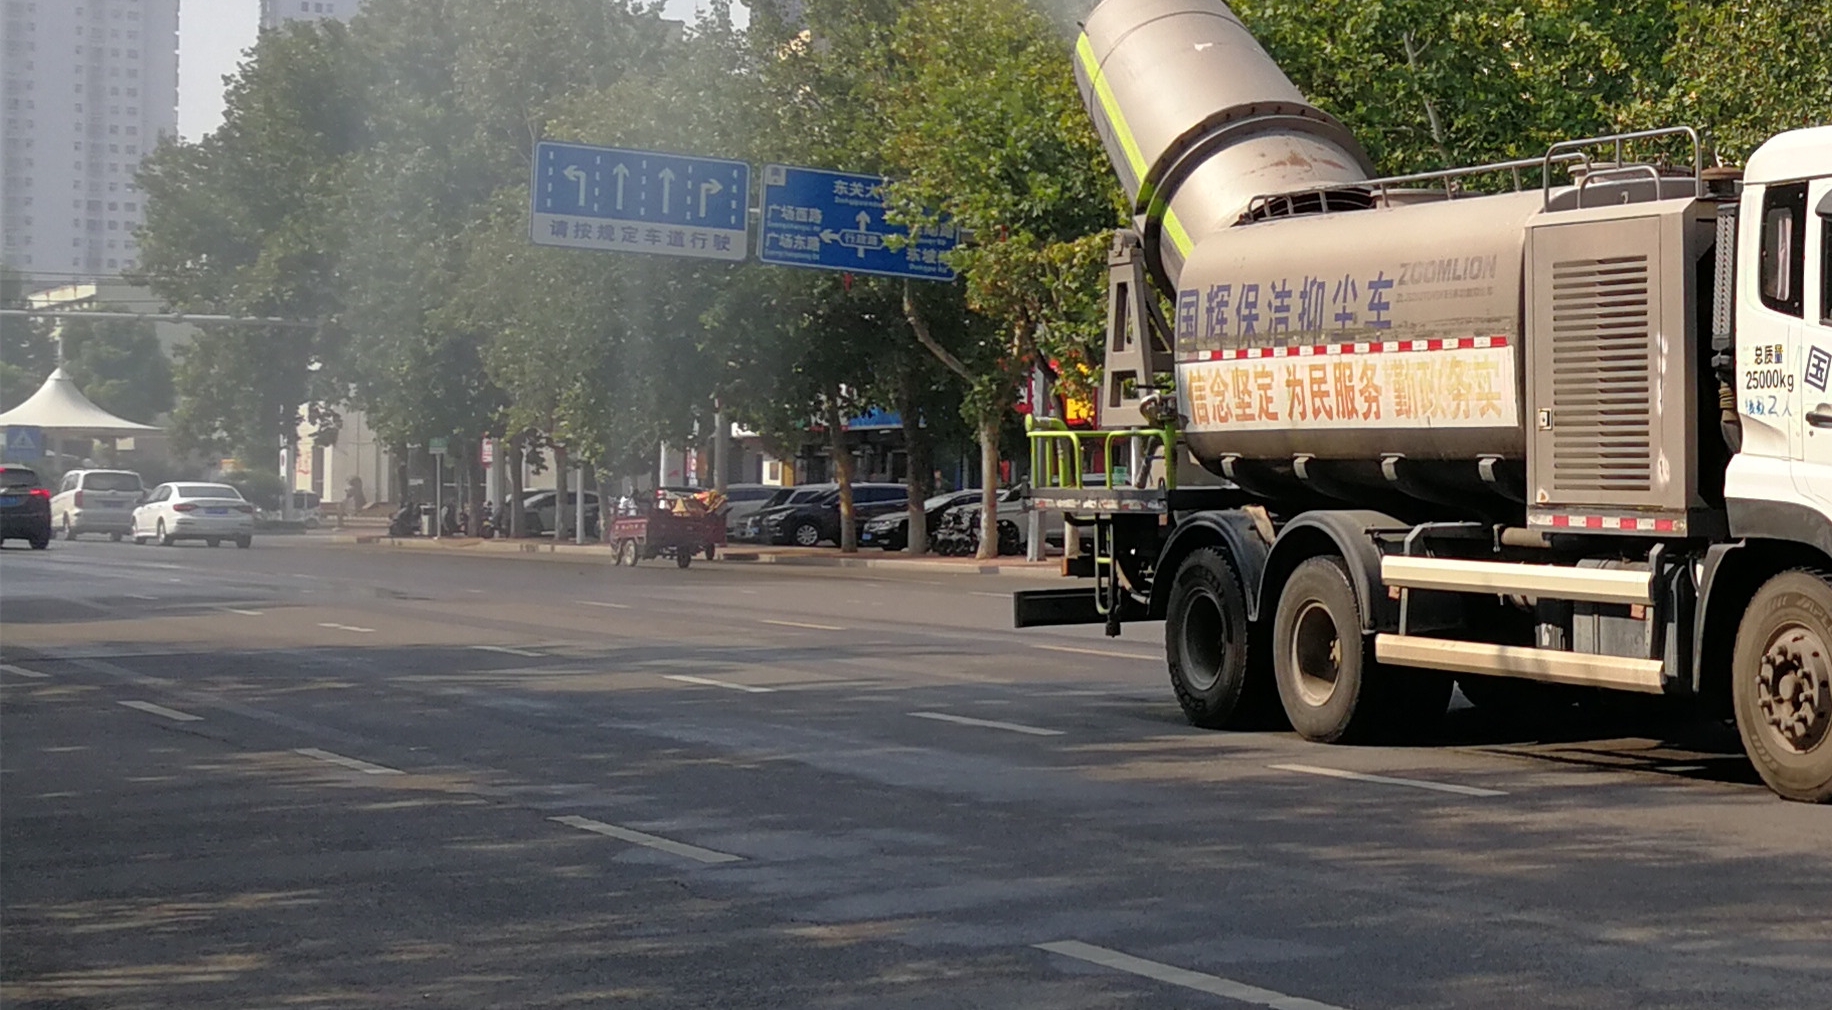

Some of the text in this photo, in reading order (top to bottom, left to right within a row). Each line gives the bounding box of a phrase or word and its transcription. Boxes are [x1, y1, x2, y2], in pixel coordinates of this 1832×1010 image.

[549, 219, 732, 252] 请按规定车道行驶
[1398, 254, 1497, 286] ZOOMLION
[1179, 271, 1394, 347] 国辉保洁抑尘车
[1754, 344, 1783, 365] 总质量
[1186, 364, 1279, 424] 信念坚定
[1285, 361, 1383, 421] 为民服务
[1745, 369, 1794, 393] 25000kg
